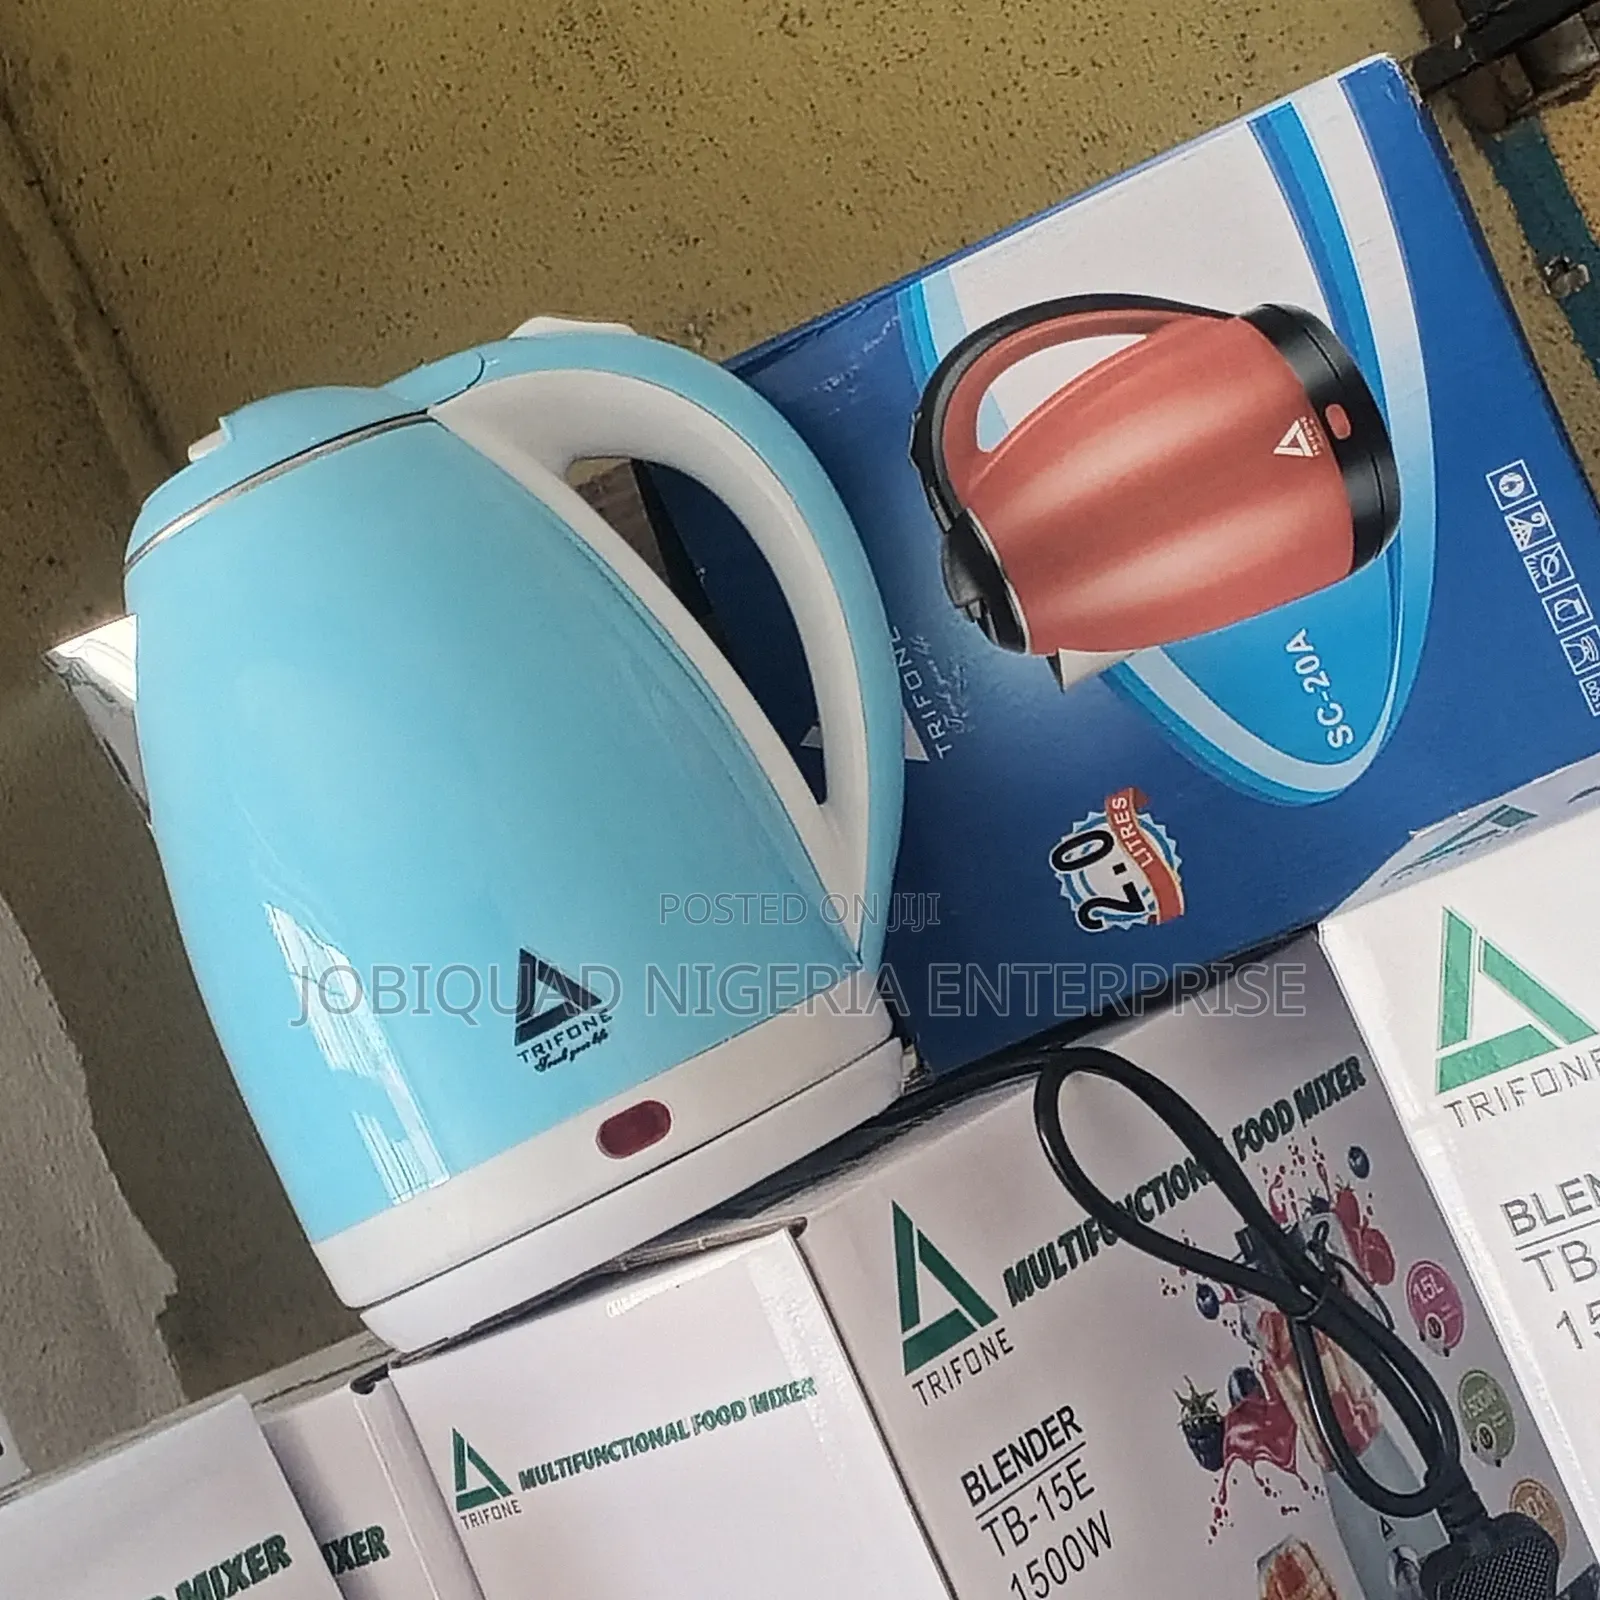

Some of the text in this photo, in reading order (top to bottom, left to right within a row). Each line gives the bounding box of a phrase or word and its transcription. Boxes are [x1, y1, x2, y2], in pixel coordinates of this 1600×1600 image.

[1285, 628, 1354, 748] SC-20A
[1111, 796, 1153, 868] LITRES
[1051, 829, 1146, 931] 2.0
[516, 1008, 613, 1063] TRIFONE
[1231, 1098, 1295, 1162] FOOD
[1293, 1055, 1366, 1128] MIXER
[911, 1327, 1014, 1407] TRIFONE
[517, 1376, 818, 1491] MULTIFUNCTIONAL FOOD MIXER
[960, 1404, 1083, 1508] BLENDER
[321, 1524, 391, 1576] IXER
[459, 1499, 523, 1531] TRIFONE
[980, 1457, 1095, 1557] TB-15E
[174, 1534, 293, 1600] MIXER
[1010, 1509, 1112, 1600] 1500W
